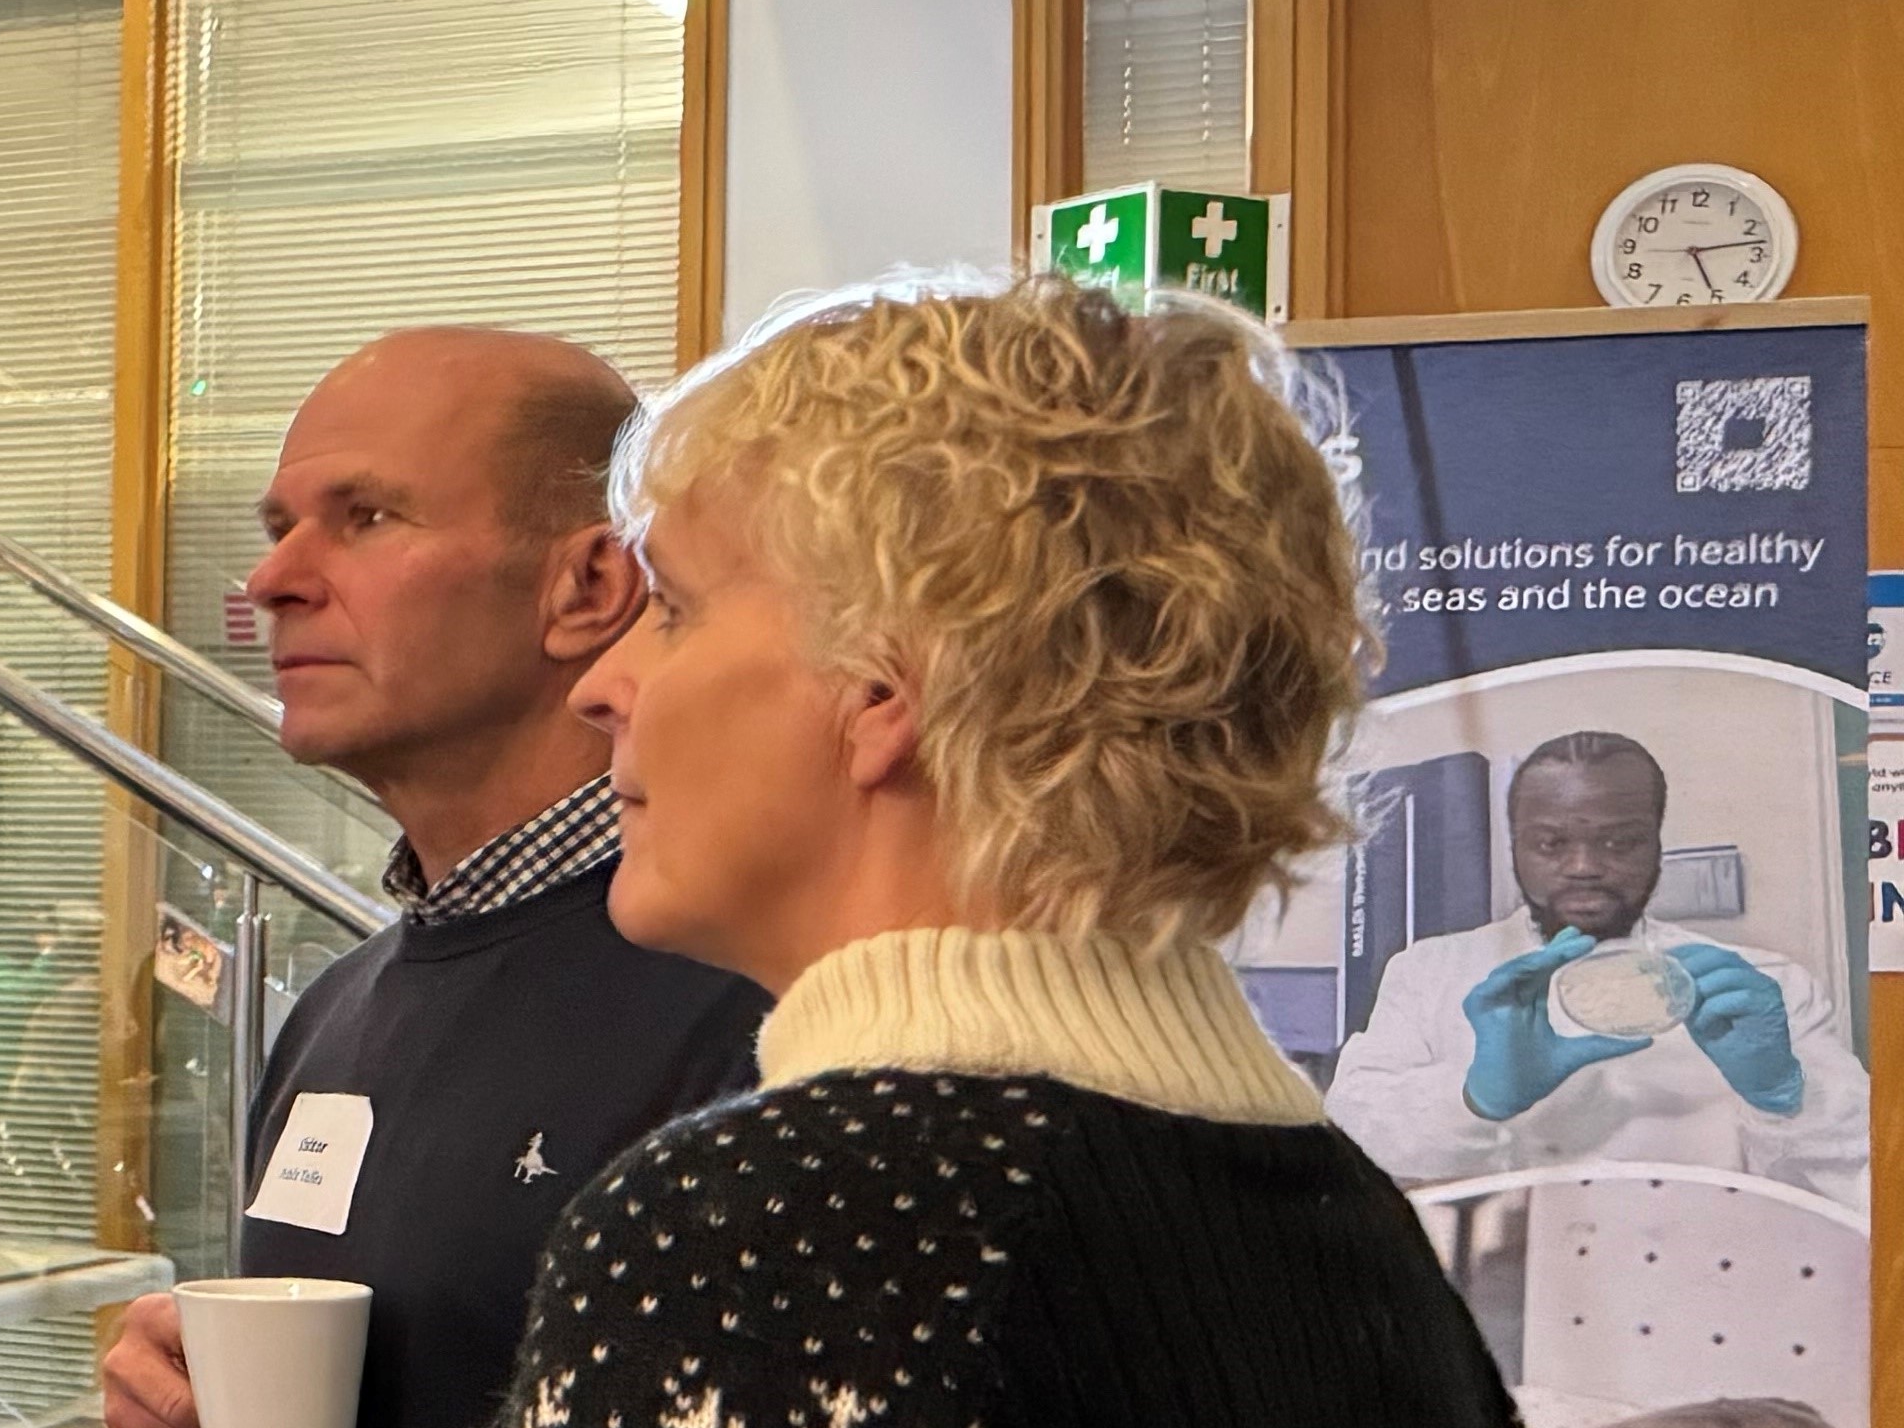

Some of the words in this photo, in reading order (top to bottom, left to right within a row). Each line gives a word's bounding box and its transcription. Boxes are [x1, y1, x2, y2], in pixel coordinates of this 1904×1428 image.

[1659, 198, 1678, 215] 11
[1692, 189, 1710, 208] 12
[1728, 201, 1737, 217] 1
[1638, 216, 1660, 233] 10
[1743, 219, 1758, 236] 2
[1622, 239, 1636, 255] 9
[1750, 247, 1764, 263] 3
[1627, 262, 1642, 280] 8
[1734, 270, 1750, 287] 4
[1645, 283, 1663, 304] 7
[1710, 289, 1726, 305] 5
[1359, 539, 1408, 572] nd
[1418, 537, 1595, 571] solutions
[1605, 535, 1664, 568] for
[1674, 530, 1826, 573] healthy
[1402, 585, 1488, 613] seas
[1497, 578, 1571, 611] and
[1583, 577, 1648, 610] the
[1658, 581, 1779, 610] ocean
